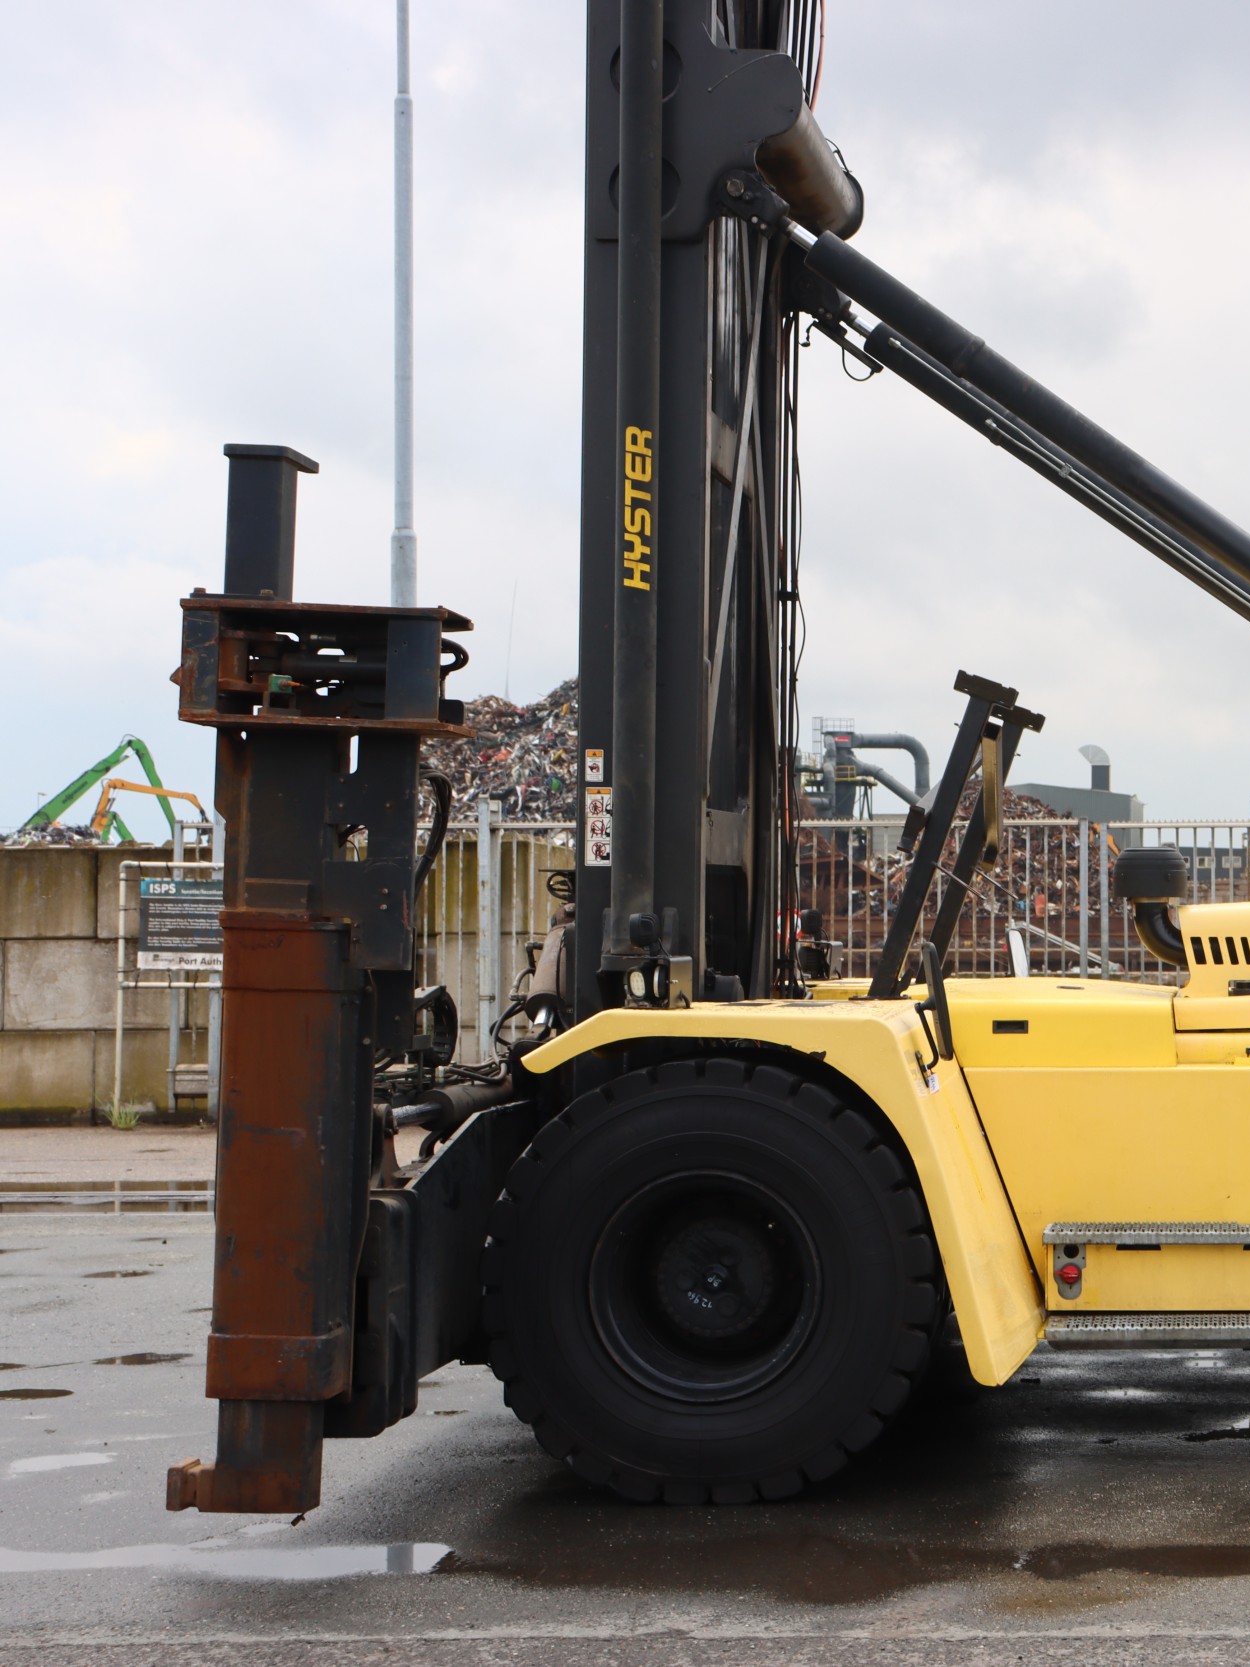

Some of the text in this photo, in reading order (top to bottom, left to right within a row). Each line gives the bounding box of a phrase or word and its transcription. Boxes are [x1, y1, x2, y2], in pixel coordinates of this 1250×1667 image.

[623, 425, 653, 592] HYSTER
[149, 883, 176, 894] ISPS
[178, 957, 197, 965] Port
